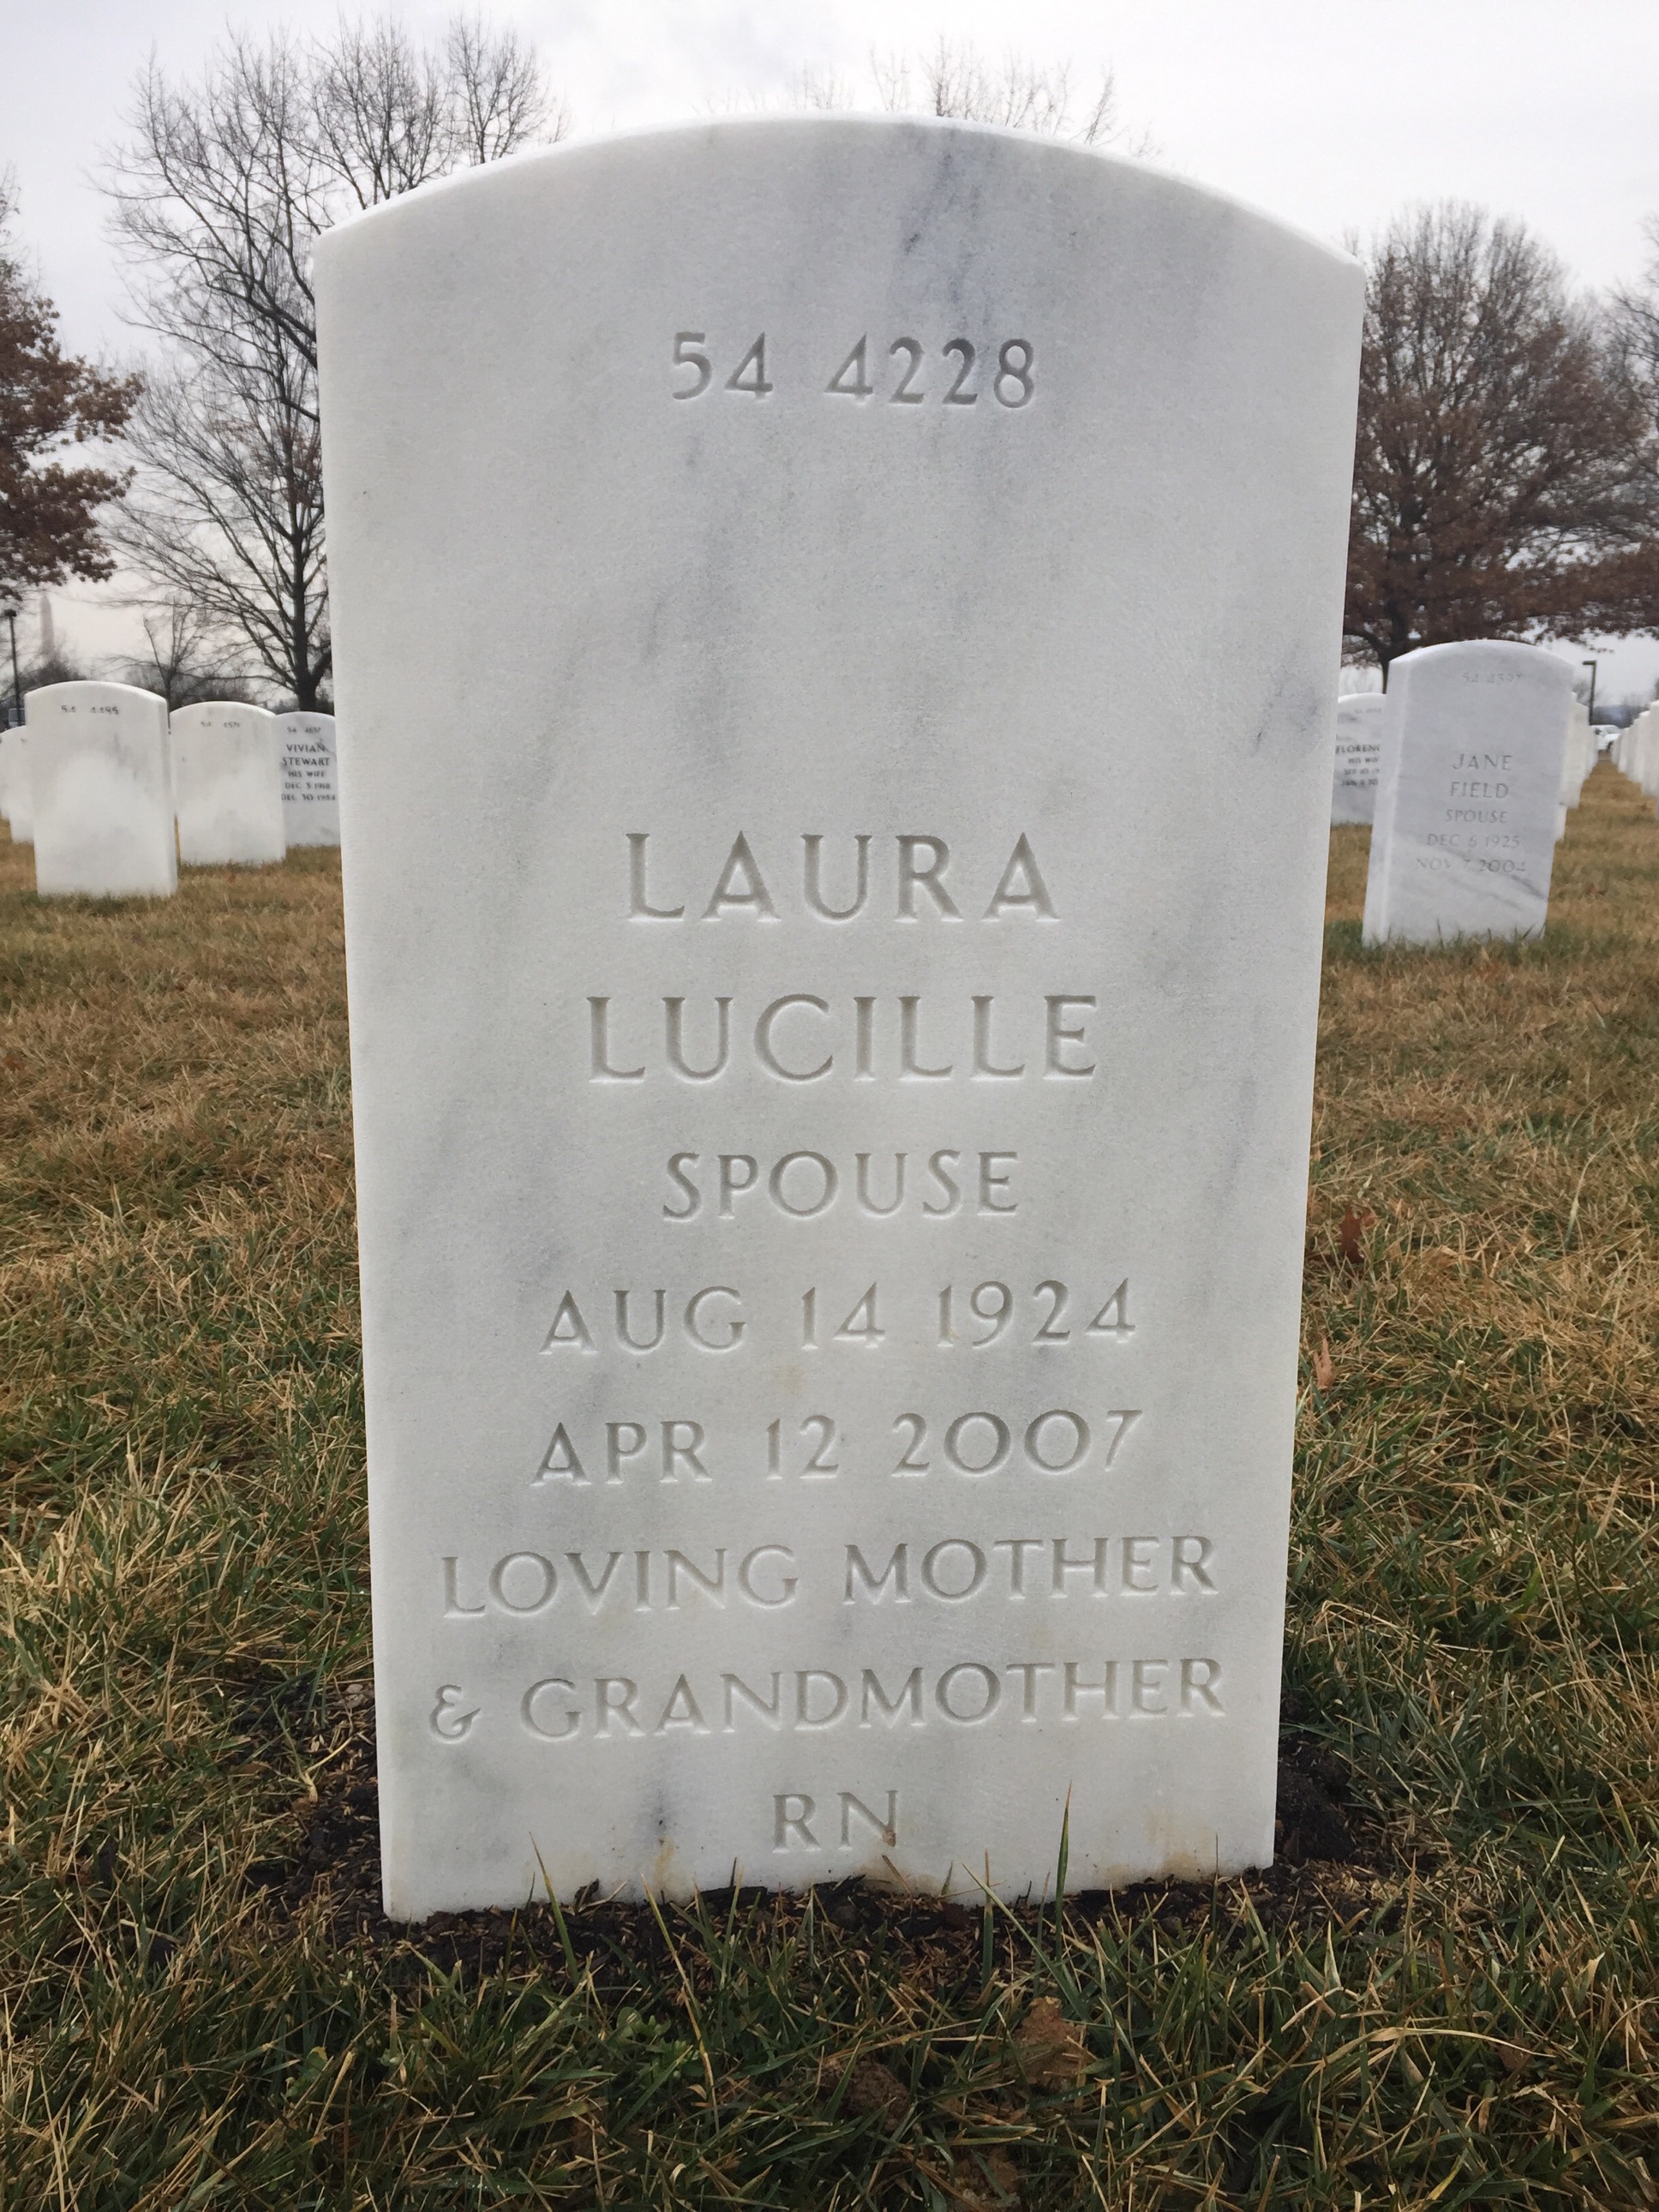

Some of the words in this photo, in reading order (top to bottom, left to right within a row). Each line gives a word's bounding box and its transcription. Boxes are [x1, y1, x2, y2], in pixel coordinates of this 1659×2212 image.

[673, 332, 773, 400] 54
[824, 332, 1034, 408] 4228
[282, 757, 330, 766] STEWART
[286, 744, 326, 752] VIVIAN
[1452, 753, 1512, 770] JANE
[1445, 809, 1507, 824] SPOUSE
[1450, 781, 1509, 799] FIELD
[1416, 857, 1452, 871] NOV
[1479, 859, 1525, 872] 2004
[1427, 833, 1461, 847] DEC
[1485, 835, 1520, 848] 1925
[626, 830, 1062, 922] LAURA
[586, 993, 1097, 1083] LUCILLE
[662, 1150, 1018, 1221] SPOUSE
[539, 1286, 747, 1355] AUG
[801, 1282, 885, 1350] 14
[937, 1278, 1136, 1349] 1924
[530, 1420, 713, 1485] APR
[767, 1414, 840, 1480] 12
[891, 1408, 1143, 1478] 2007
[441, 1544, 799, 1618] LOVING
[841, 1535, 1219, 1605] MOTHER
[429, 1684, 482, 1744] &
[520, 1658, 1225, 1742] GRANDMOTHER
[772, 1789, 899, 1853] RN
